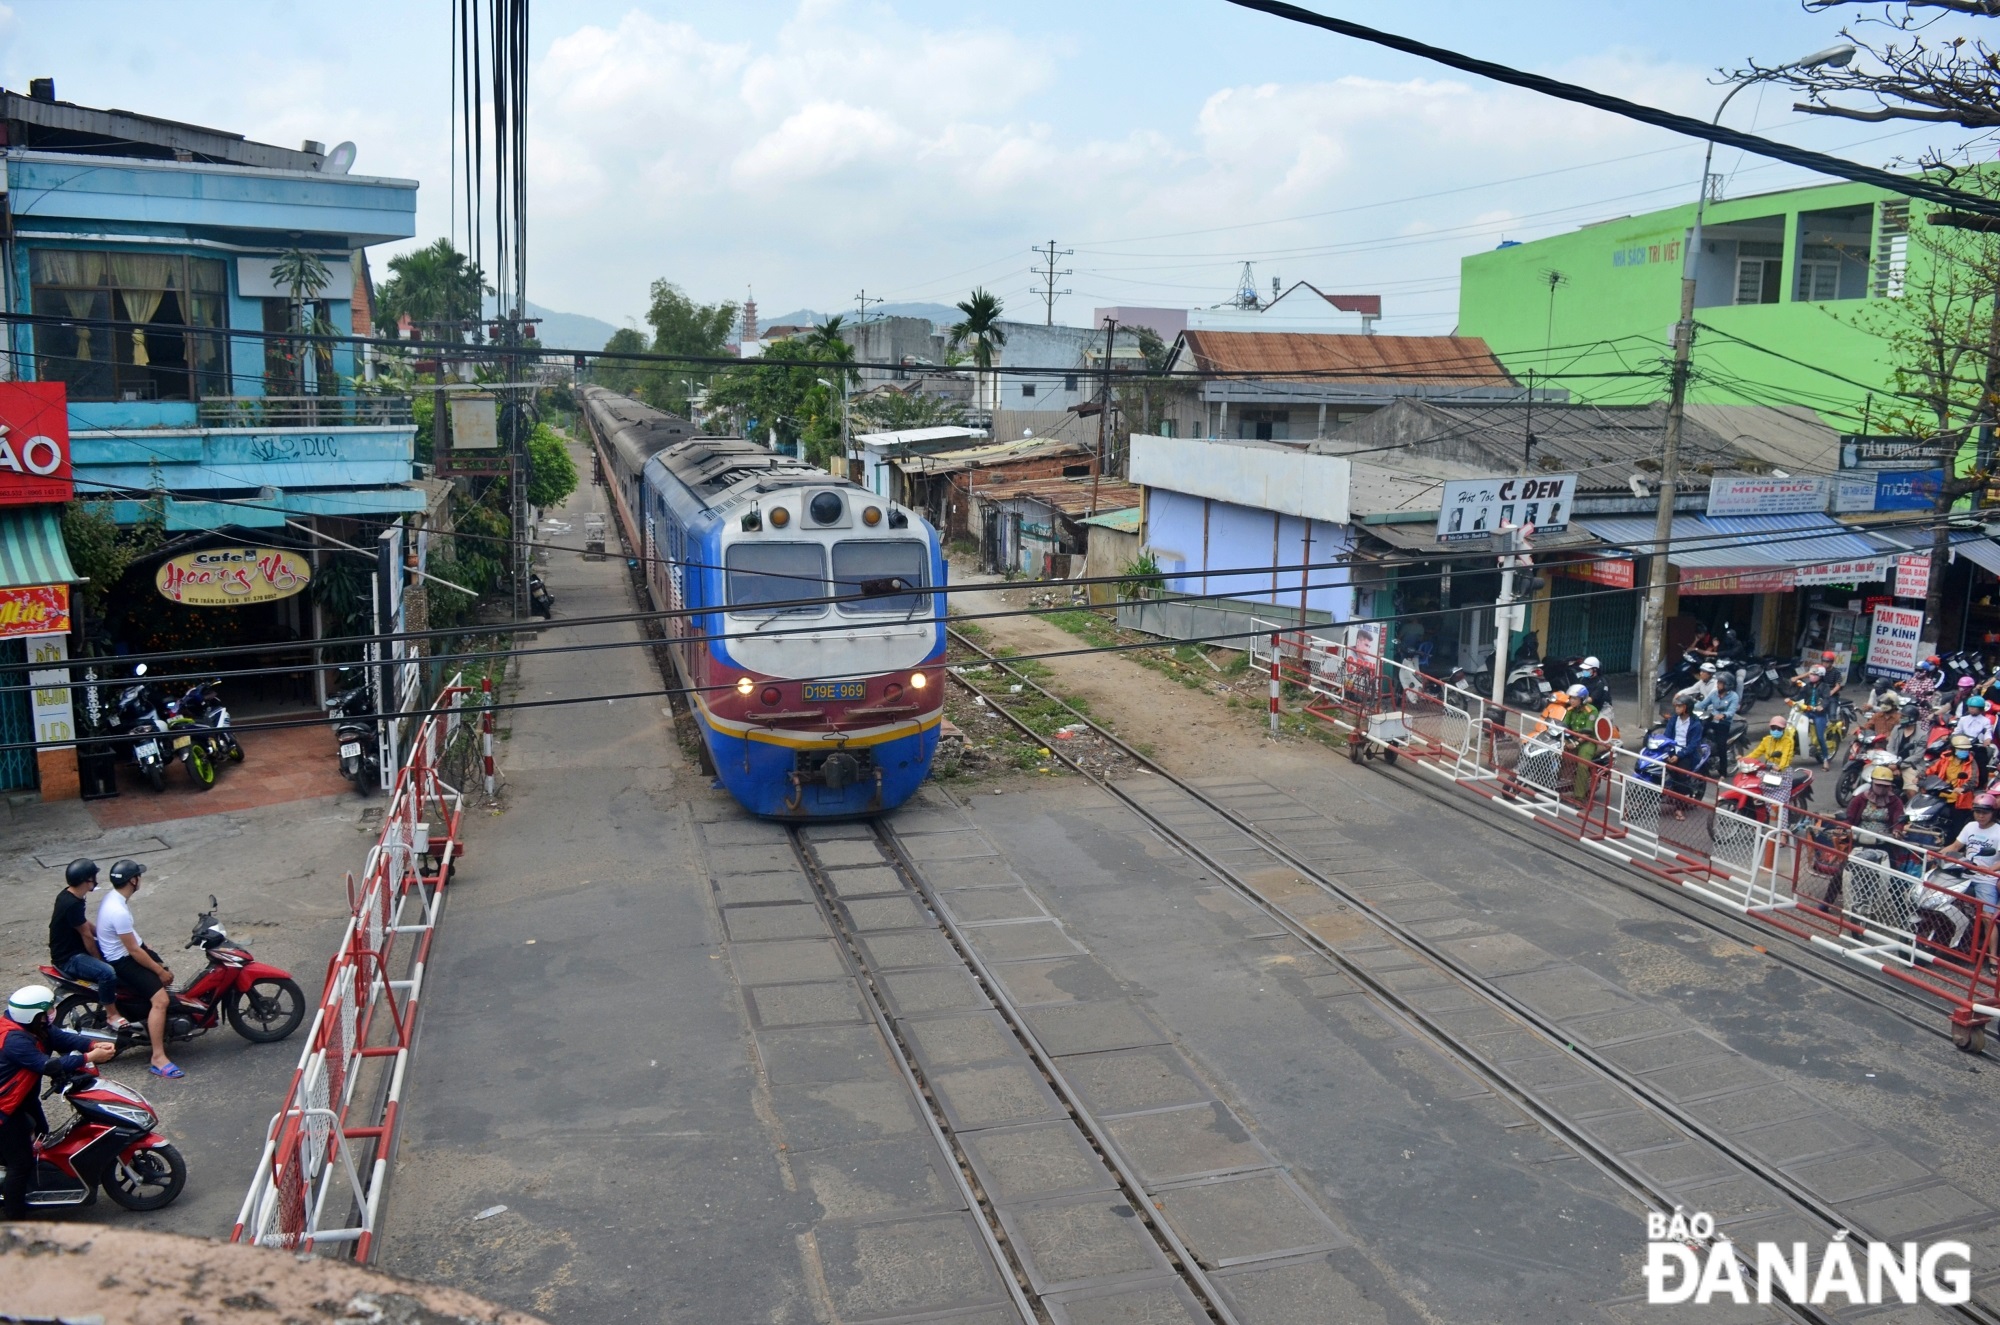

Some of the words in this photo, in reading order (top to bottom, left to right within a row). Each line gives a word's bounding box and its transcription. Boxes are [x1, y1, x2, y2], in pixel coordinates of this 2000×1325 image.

[1649, 240, 1661, 263] TRÍ
[1664, 237, 1681, 265] VIỆT
[1480, 490, 1495, 502] Tóc
[1521, 479, 1564, 500] ĐEN
[1731, 485, 1775, 494] MINH
[1780, 484, 1814, 493] ĐỨC
[196, 553, 242, 564] Cafe
[1899, 557, 1910, 565] ÉP
[257, 553, 310, 590] Vy
[1914, 568, 1928, 577] BÁN
[1877, 609, 1894, 624] TÂM
[1896, 612, 1920, 628] THỊNH
[1876, 624, 1889, 636] ÉP
[1891, 626, 1917, 641] KÍNH
[1876, 638, 1894, 647] MUA
[1896, 640, 1913, 650] BÁN
[1874, 645, 1890, 655] SỬA
[1892, 649, 1913, 659] CHỮA
[1871, 655, 1889, 665] ĐIỆN
[804, 684, 864, 699] D19E-969
